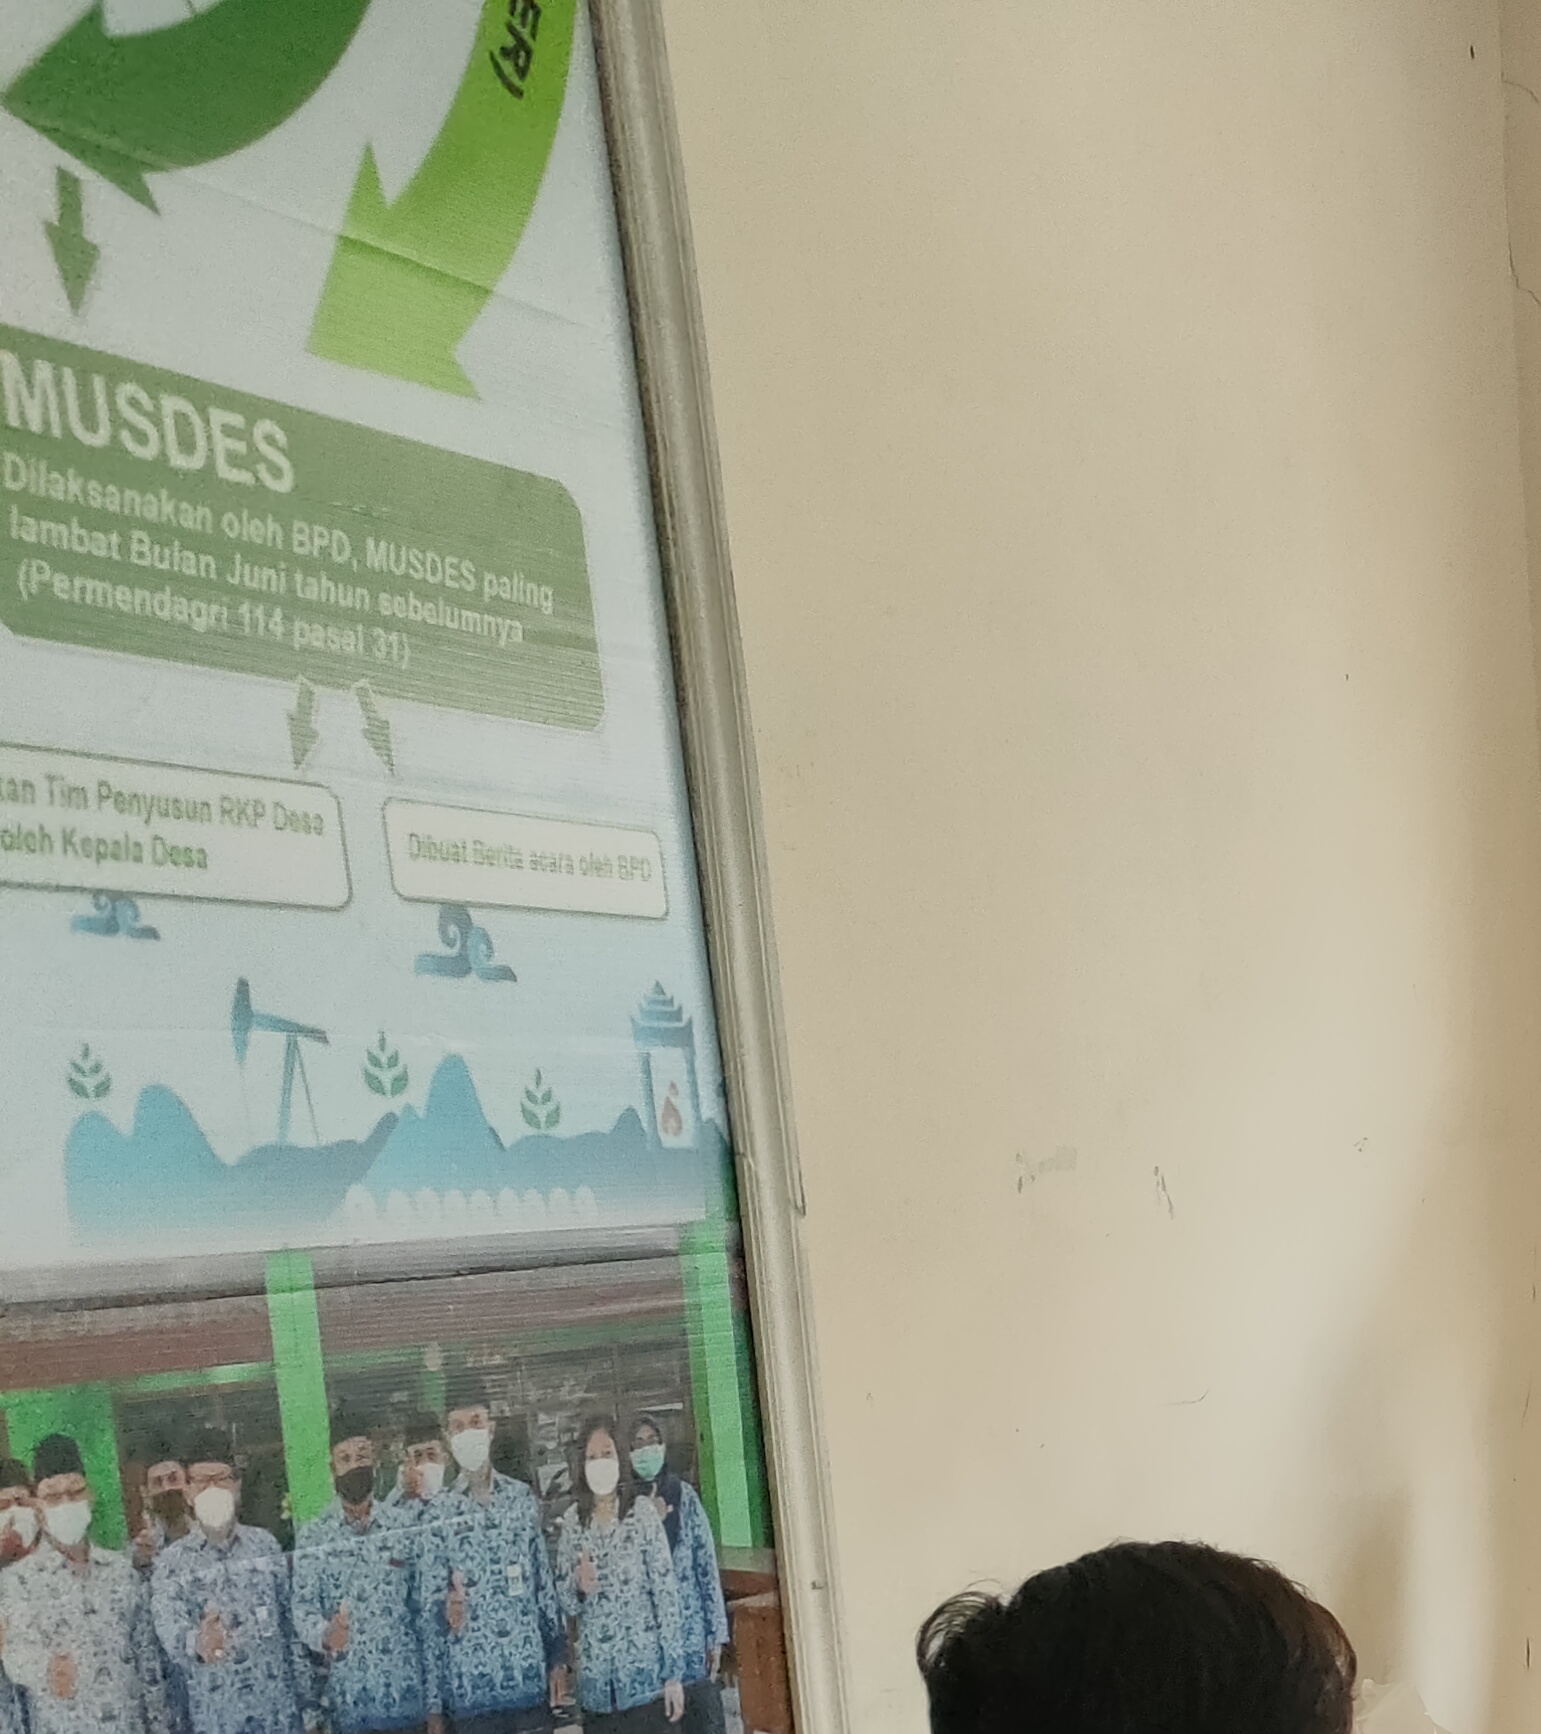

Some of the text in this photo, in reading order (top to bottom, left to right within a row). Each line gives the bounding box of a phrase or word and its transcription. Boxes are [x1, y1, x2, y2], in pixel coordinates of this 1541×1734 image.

[1, 349, 294, 493] MUSDES
[3, 452, 554, 616] Dilaksanakan oleh BPD, MUSDES paling
[9, 503, 523, 649] lambat Bulan Juni tahun sebelumnya
[18, 557, 228, 633] (Permendagri
[294, 616, 363, 655] pasal
[0, 822, 208, 870] oleh Kepala Desa
[45, 772, 88, 811] Tim
[98, 779, 213, 825] Penyusun
[219, 794, 266, 829] RKP
[273, 800, 324, 836] Desa
[408, 832, 467, 864] Dibuat
